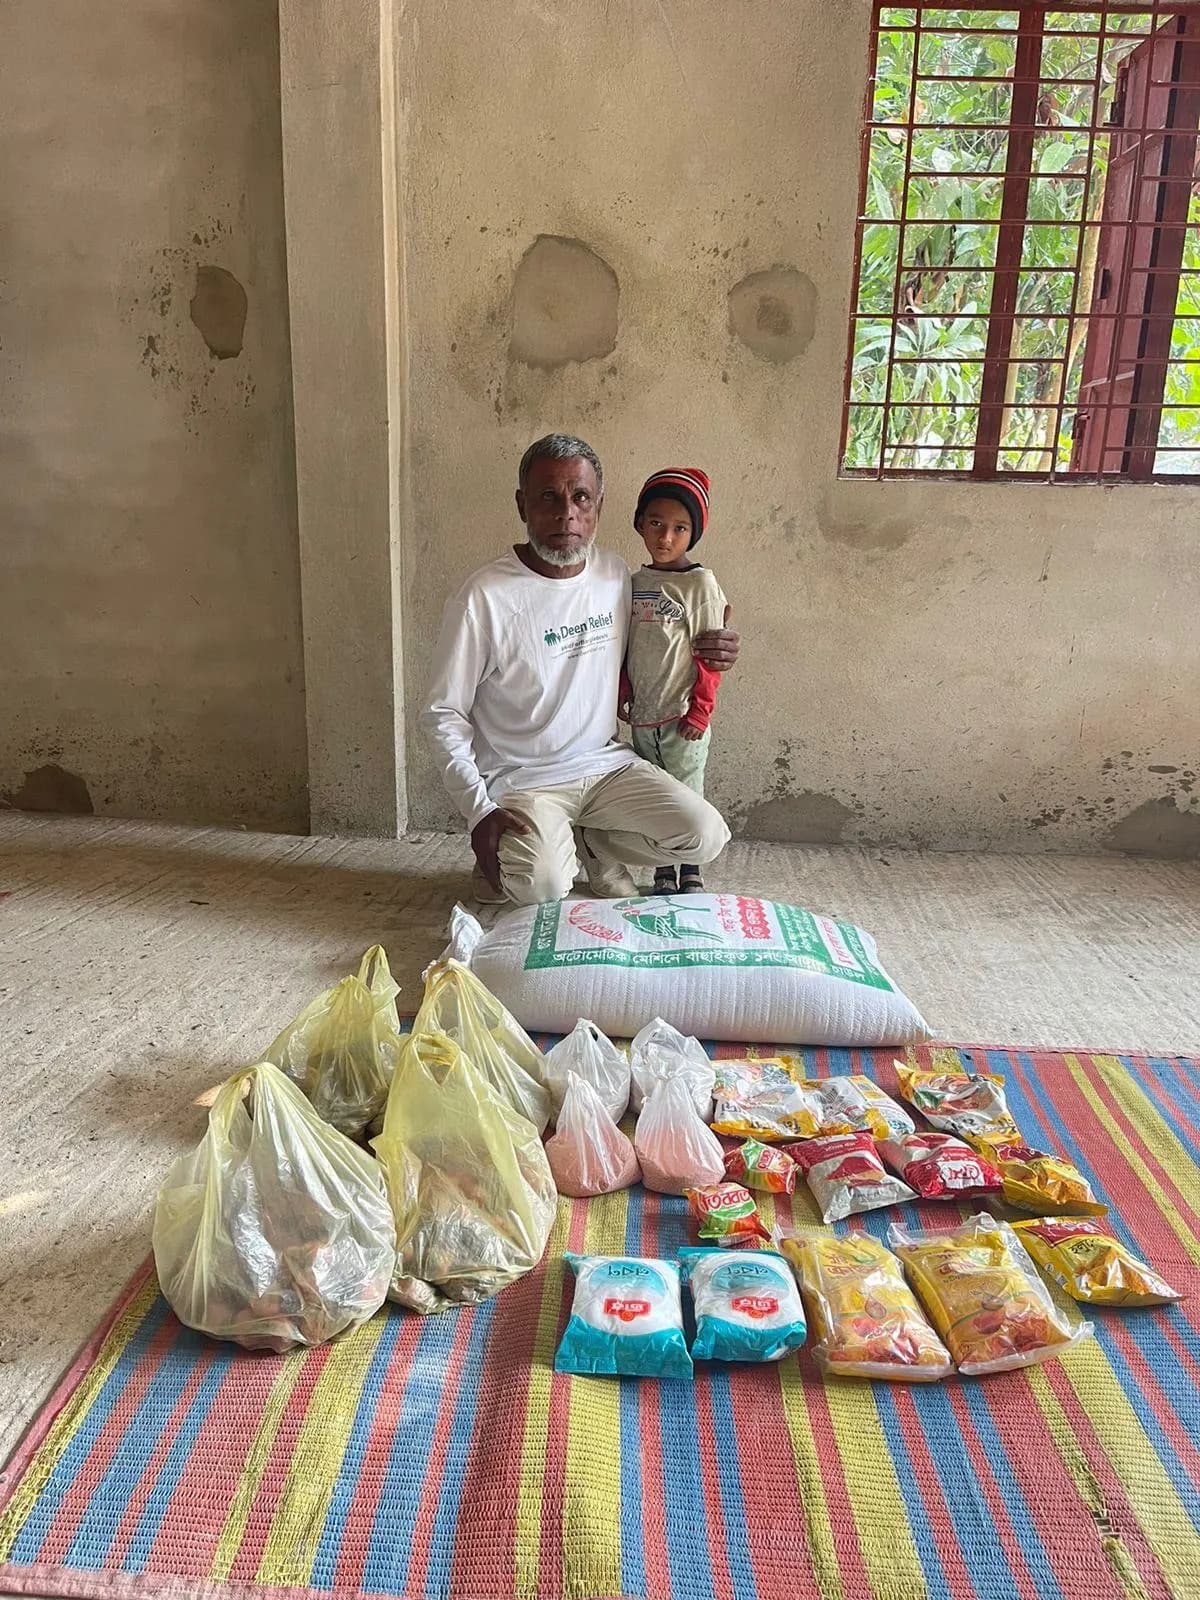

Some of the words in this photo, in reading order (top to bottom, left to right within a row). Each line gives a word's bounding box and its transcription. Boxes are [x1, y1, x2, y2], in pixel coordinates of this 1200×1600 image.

[560, 622, 588, 639] Deen
[588, 611, 614, 629] Relief
[633, 951, 680, 965] মেশিনে
[686, 949, 748, 964] বাছাইকৃত
[607, 1264, 650, 1277] লবণ
[727, 1265, 769, 1277] লবণ
